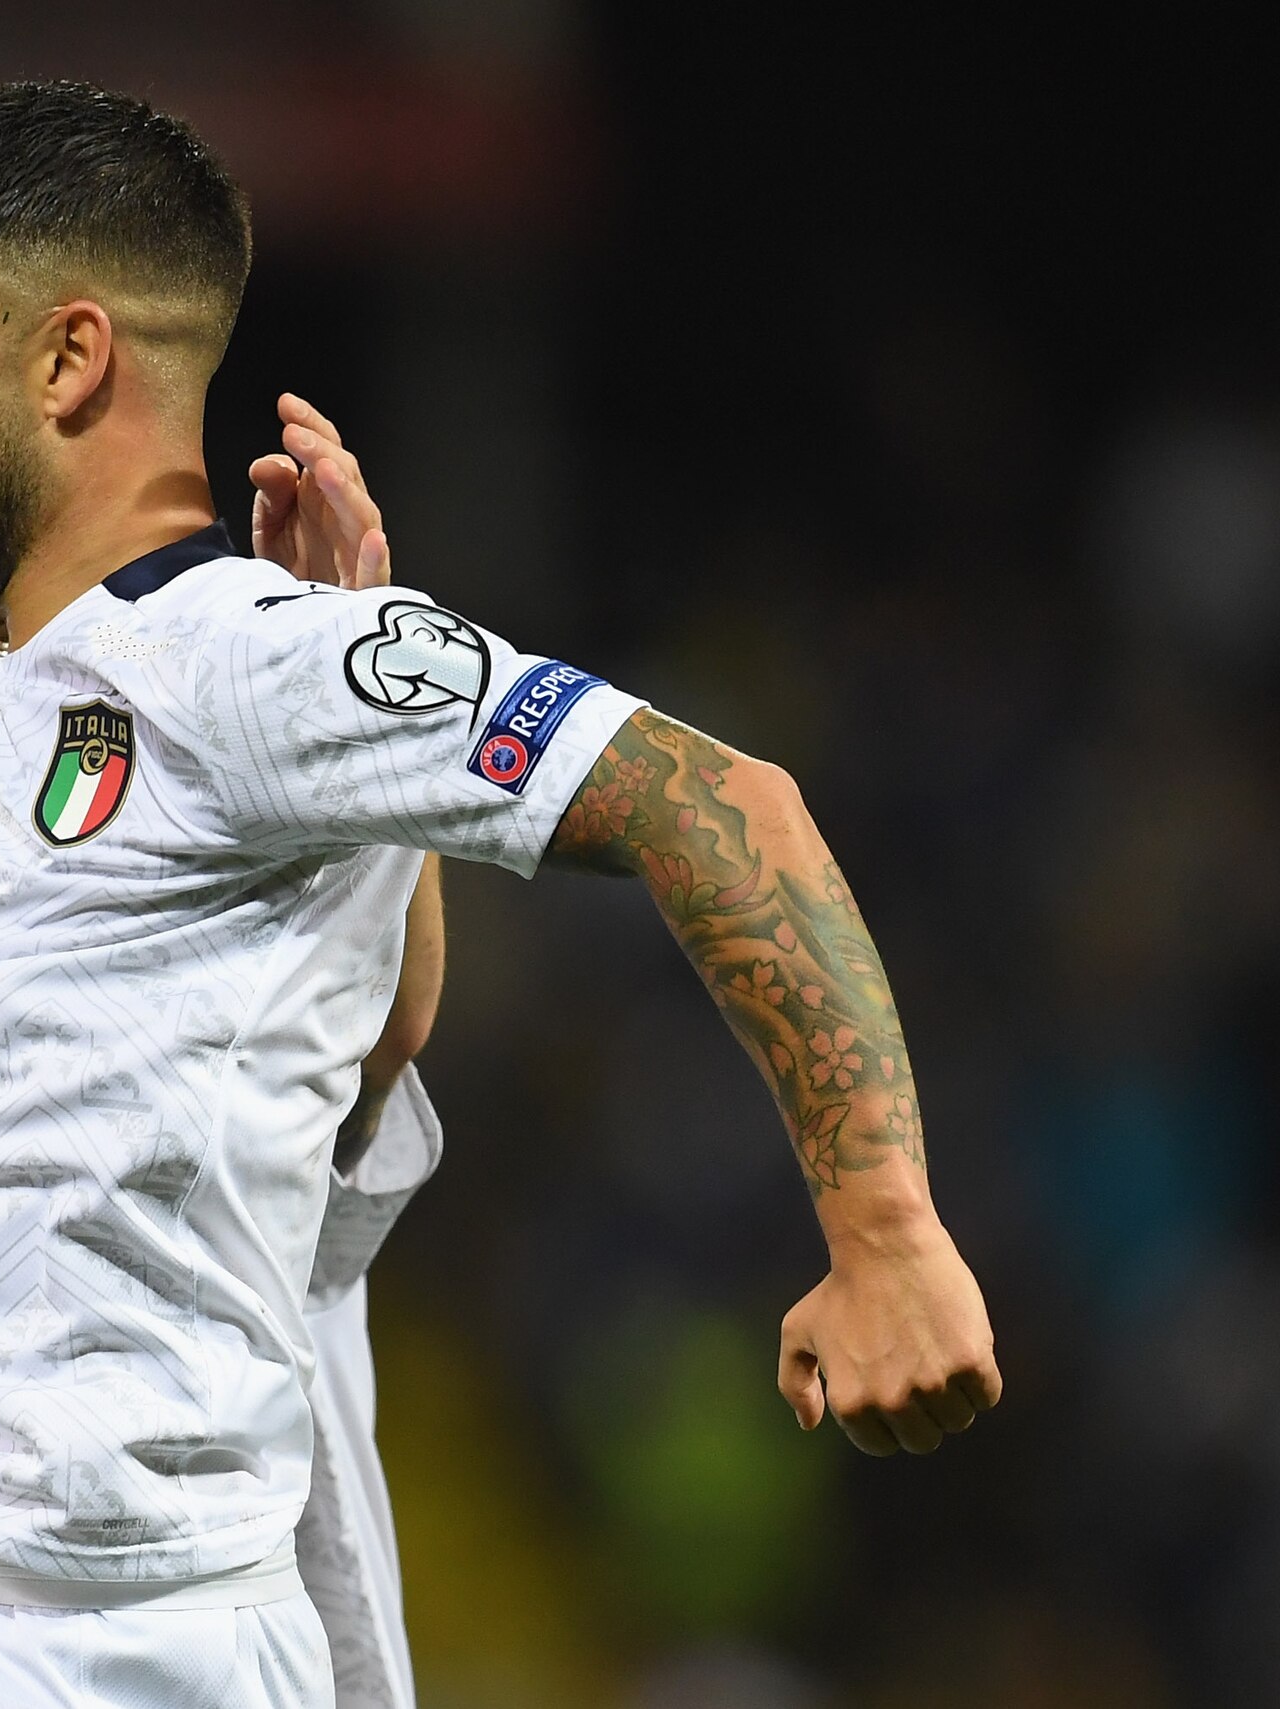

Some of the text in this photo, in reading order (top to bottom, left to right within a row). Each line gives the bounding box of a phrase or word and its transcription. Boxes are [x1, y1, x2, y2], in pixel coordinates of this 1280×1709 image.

[508, 666, 590, 738] RESPEC
[65, 715, 128, 744] ITALIA
[483, 739, 502, 767] UEFA
